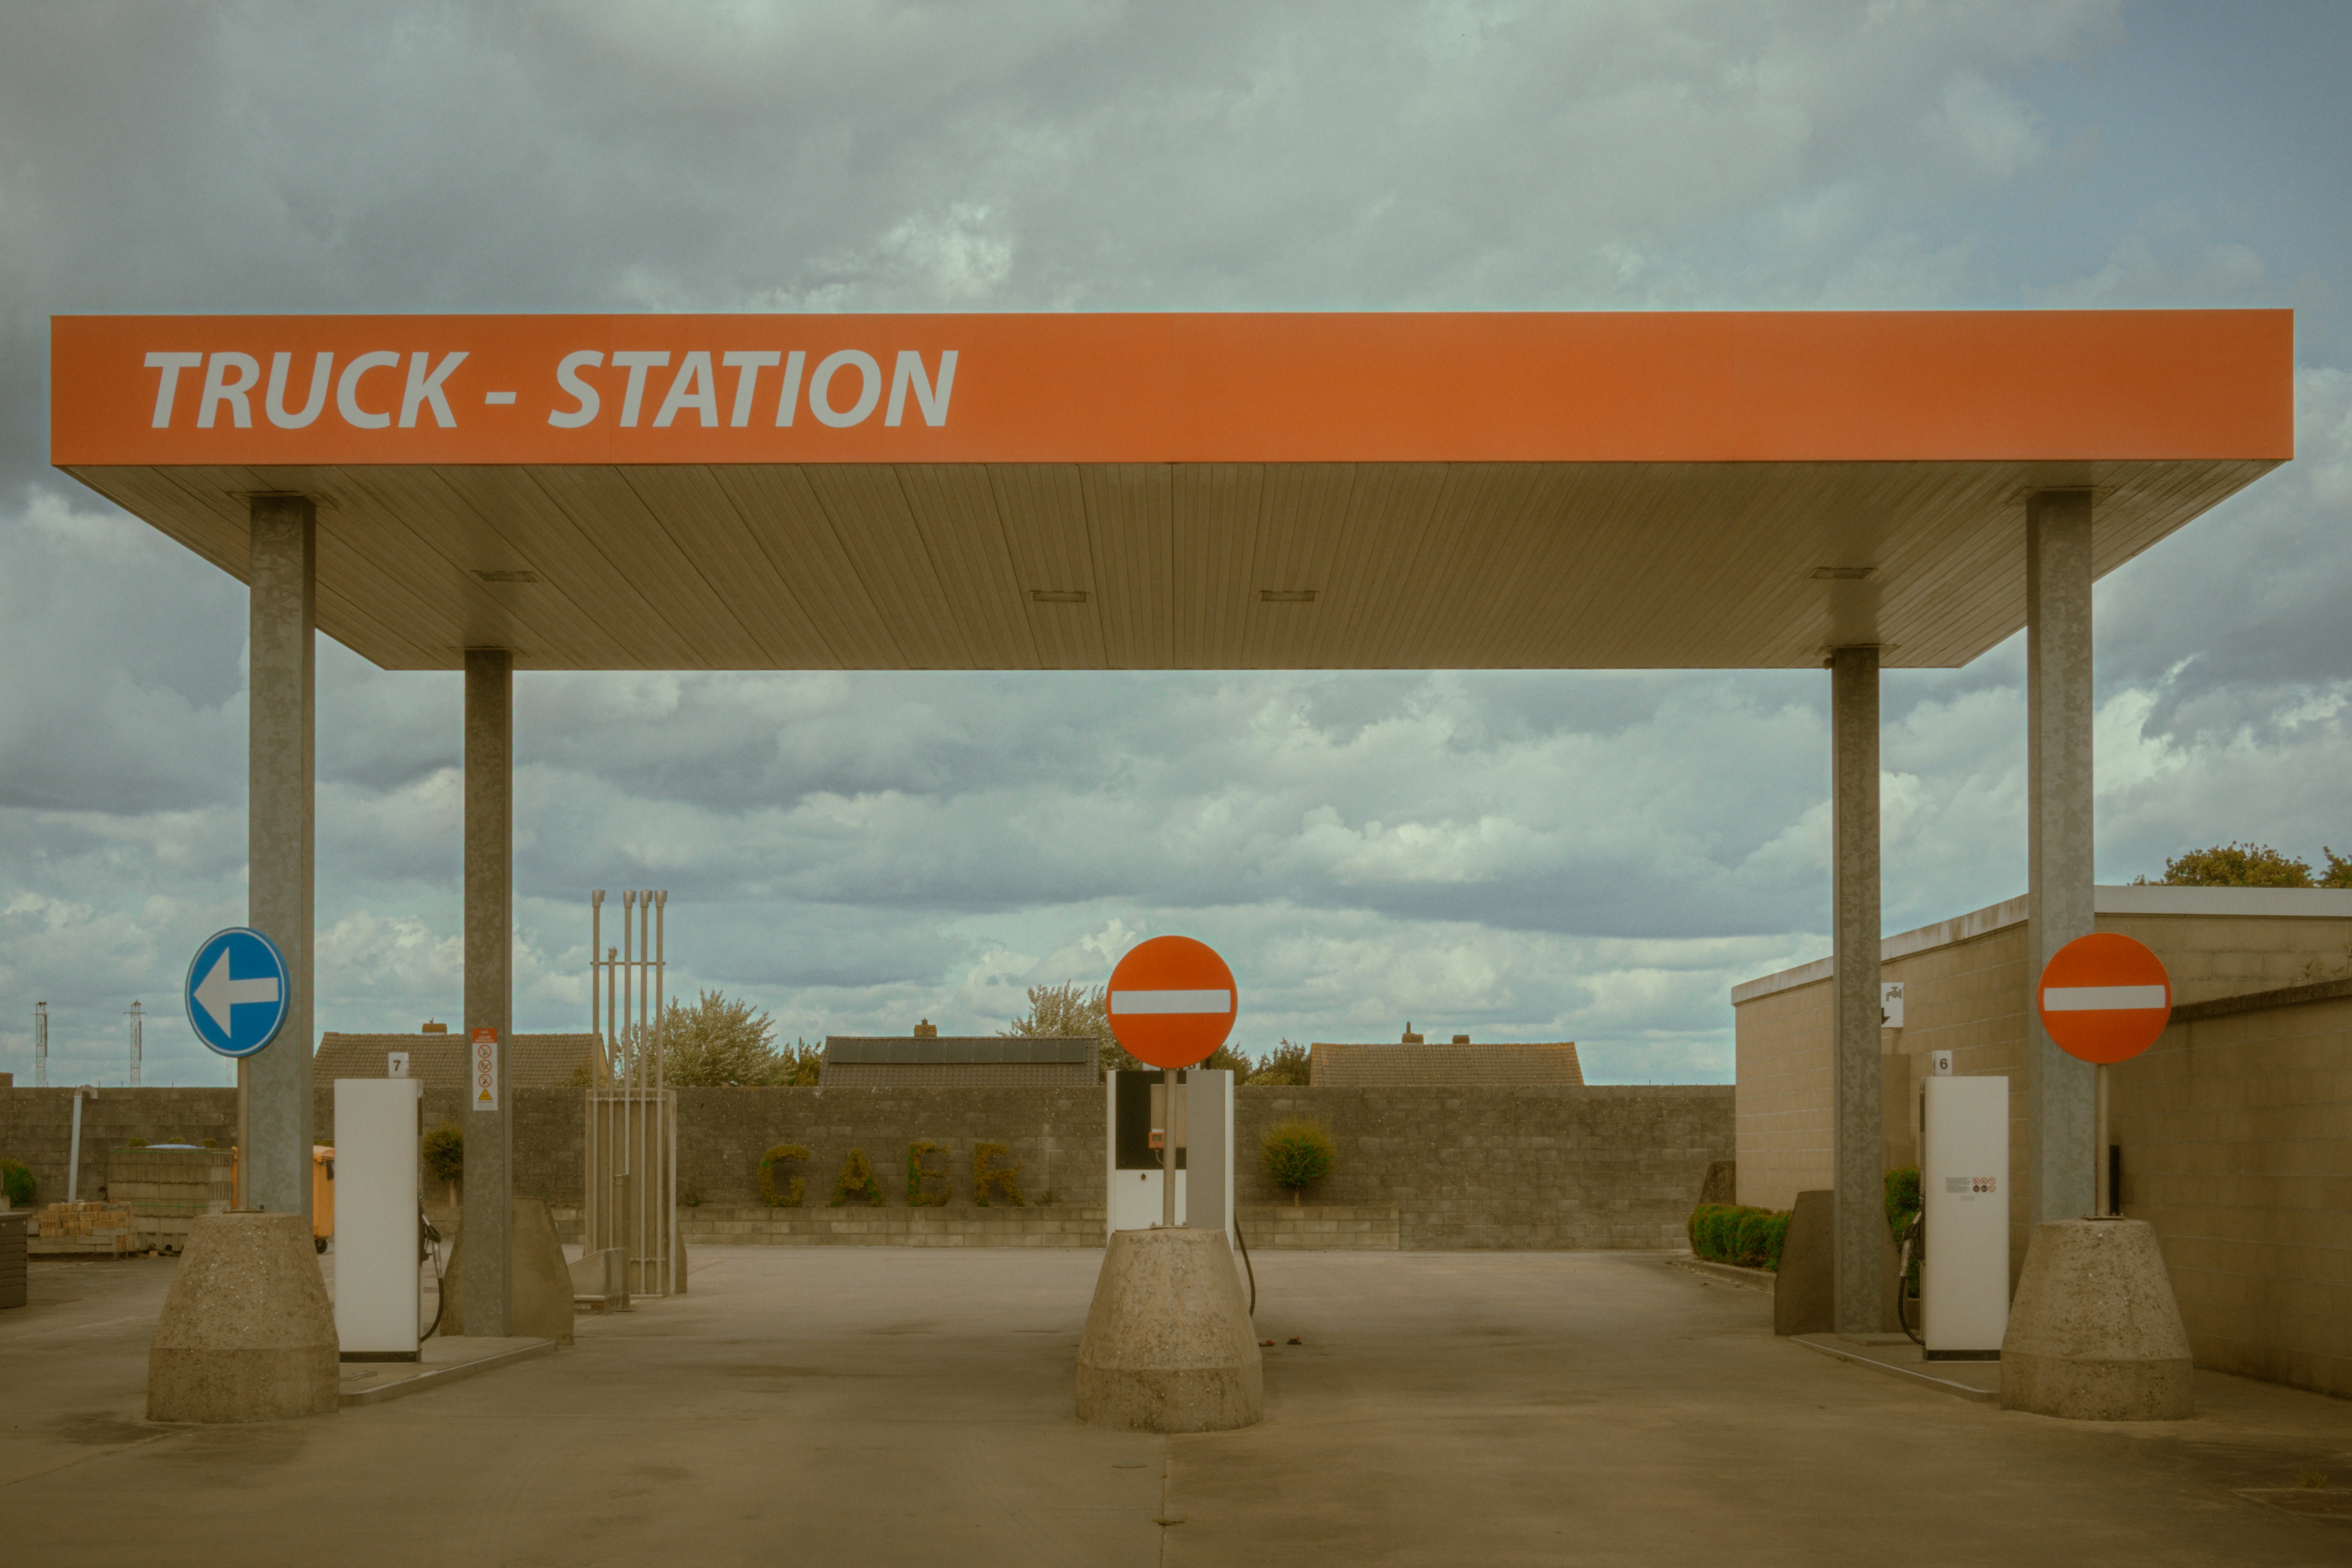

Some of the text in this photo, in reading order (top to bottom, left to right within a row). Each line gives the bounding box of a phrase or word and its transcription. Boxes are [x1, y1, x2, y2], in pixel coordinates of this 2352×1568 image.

[143, 349, 959, 429] TRUCK - STATION
[393, 1060, 401, 1071] 7
[1940, 1058, 1948, 1069] 6
